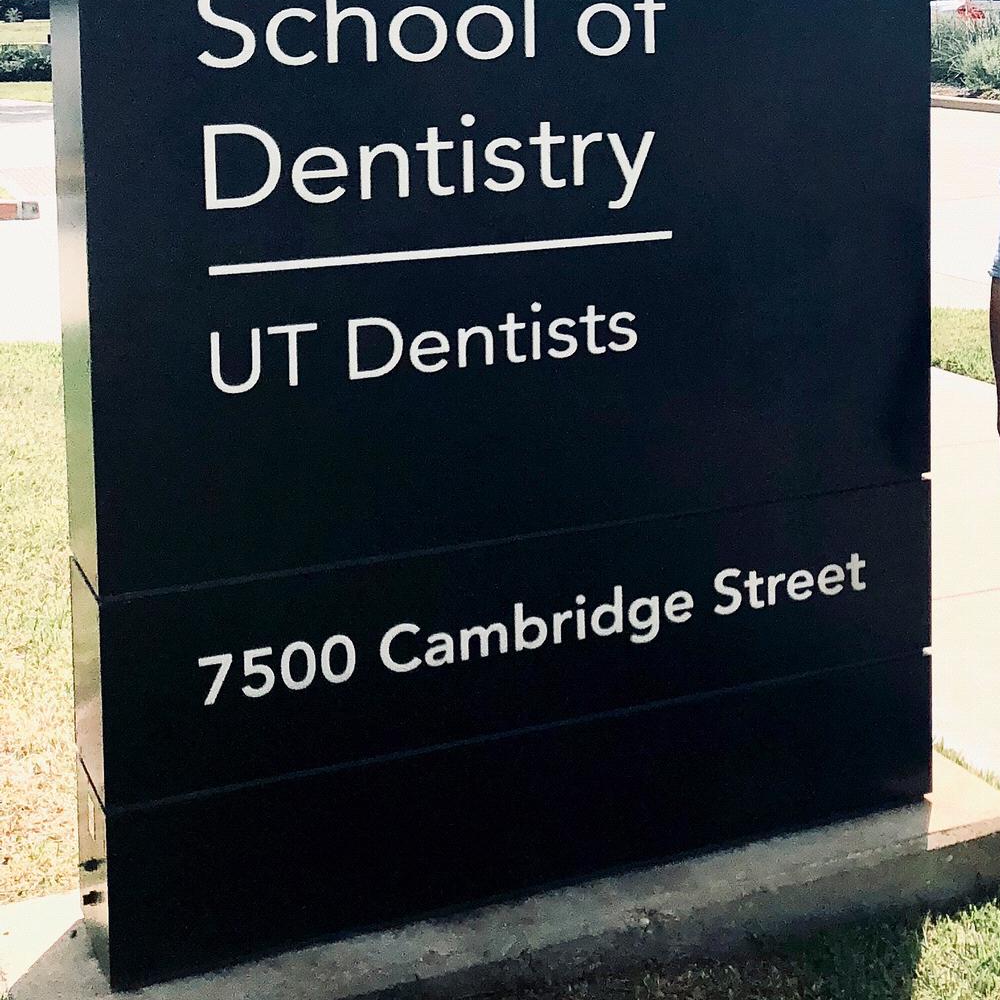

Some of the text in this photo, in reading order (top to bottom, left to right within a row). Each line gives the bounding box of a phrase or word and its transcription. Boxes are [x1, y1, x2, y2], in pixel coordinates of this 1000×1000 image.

[202, 113, 656, 210] Dentistry
[210, 301, 638, 394] UT Dentists
[198, 552, 867, 706] 7500 Cambridge Street
